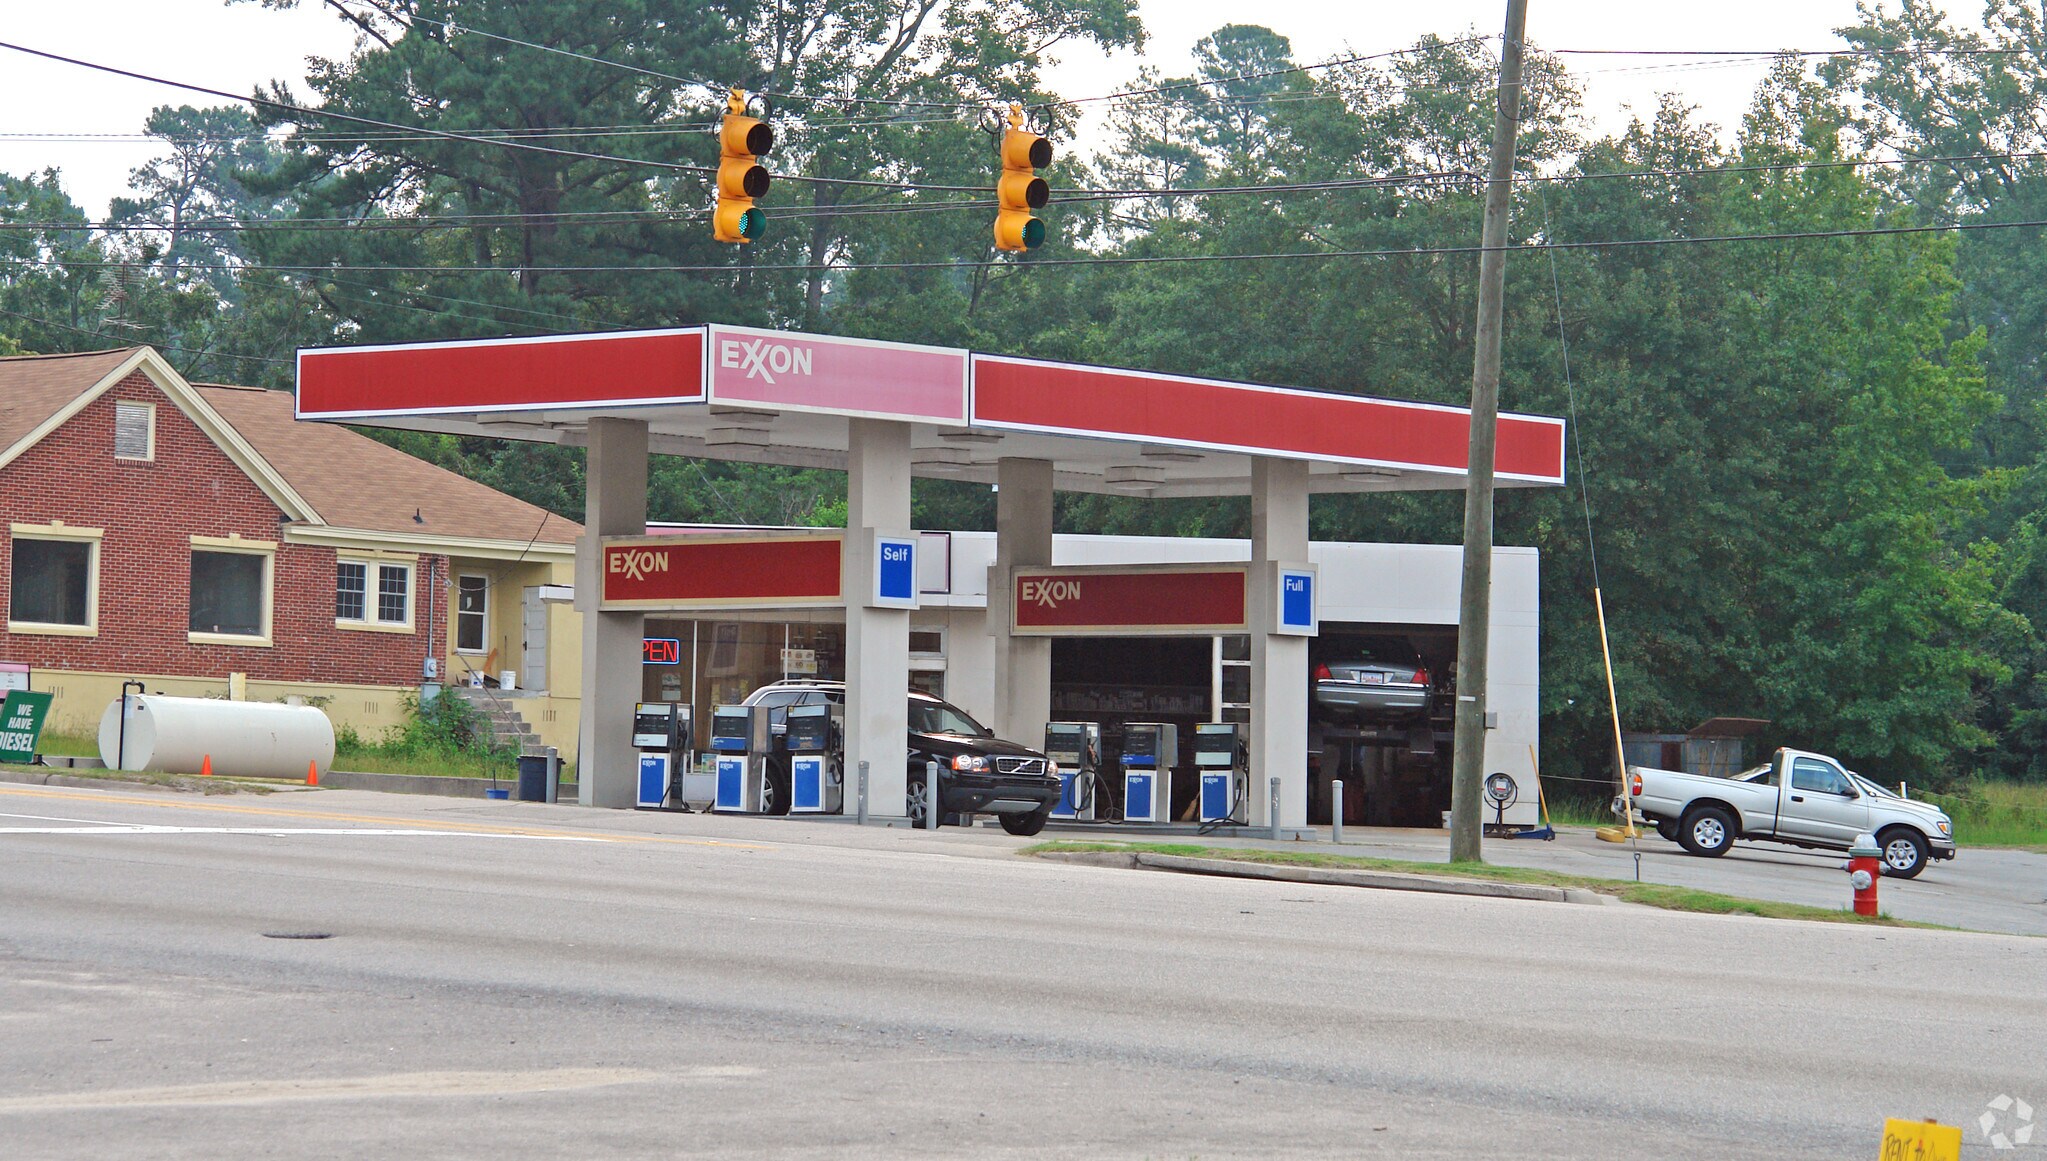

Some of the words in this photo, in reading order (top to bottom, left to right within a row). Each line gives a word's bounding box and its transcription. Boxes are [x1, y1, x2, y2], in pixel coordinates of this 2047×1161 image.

[720, 338, 812, 385] EXXON
[883, 546, 908, 562] Self
[609, 548, 669, 581] EXXON
[1021, 578, 1081, 608] EXXON
[1286, 578, 1304, 592] Full
[643, 640, 677, 662] PEN
[17, 704, 33, 716] WE
[7, 717, 33, 730] HAVE
